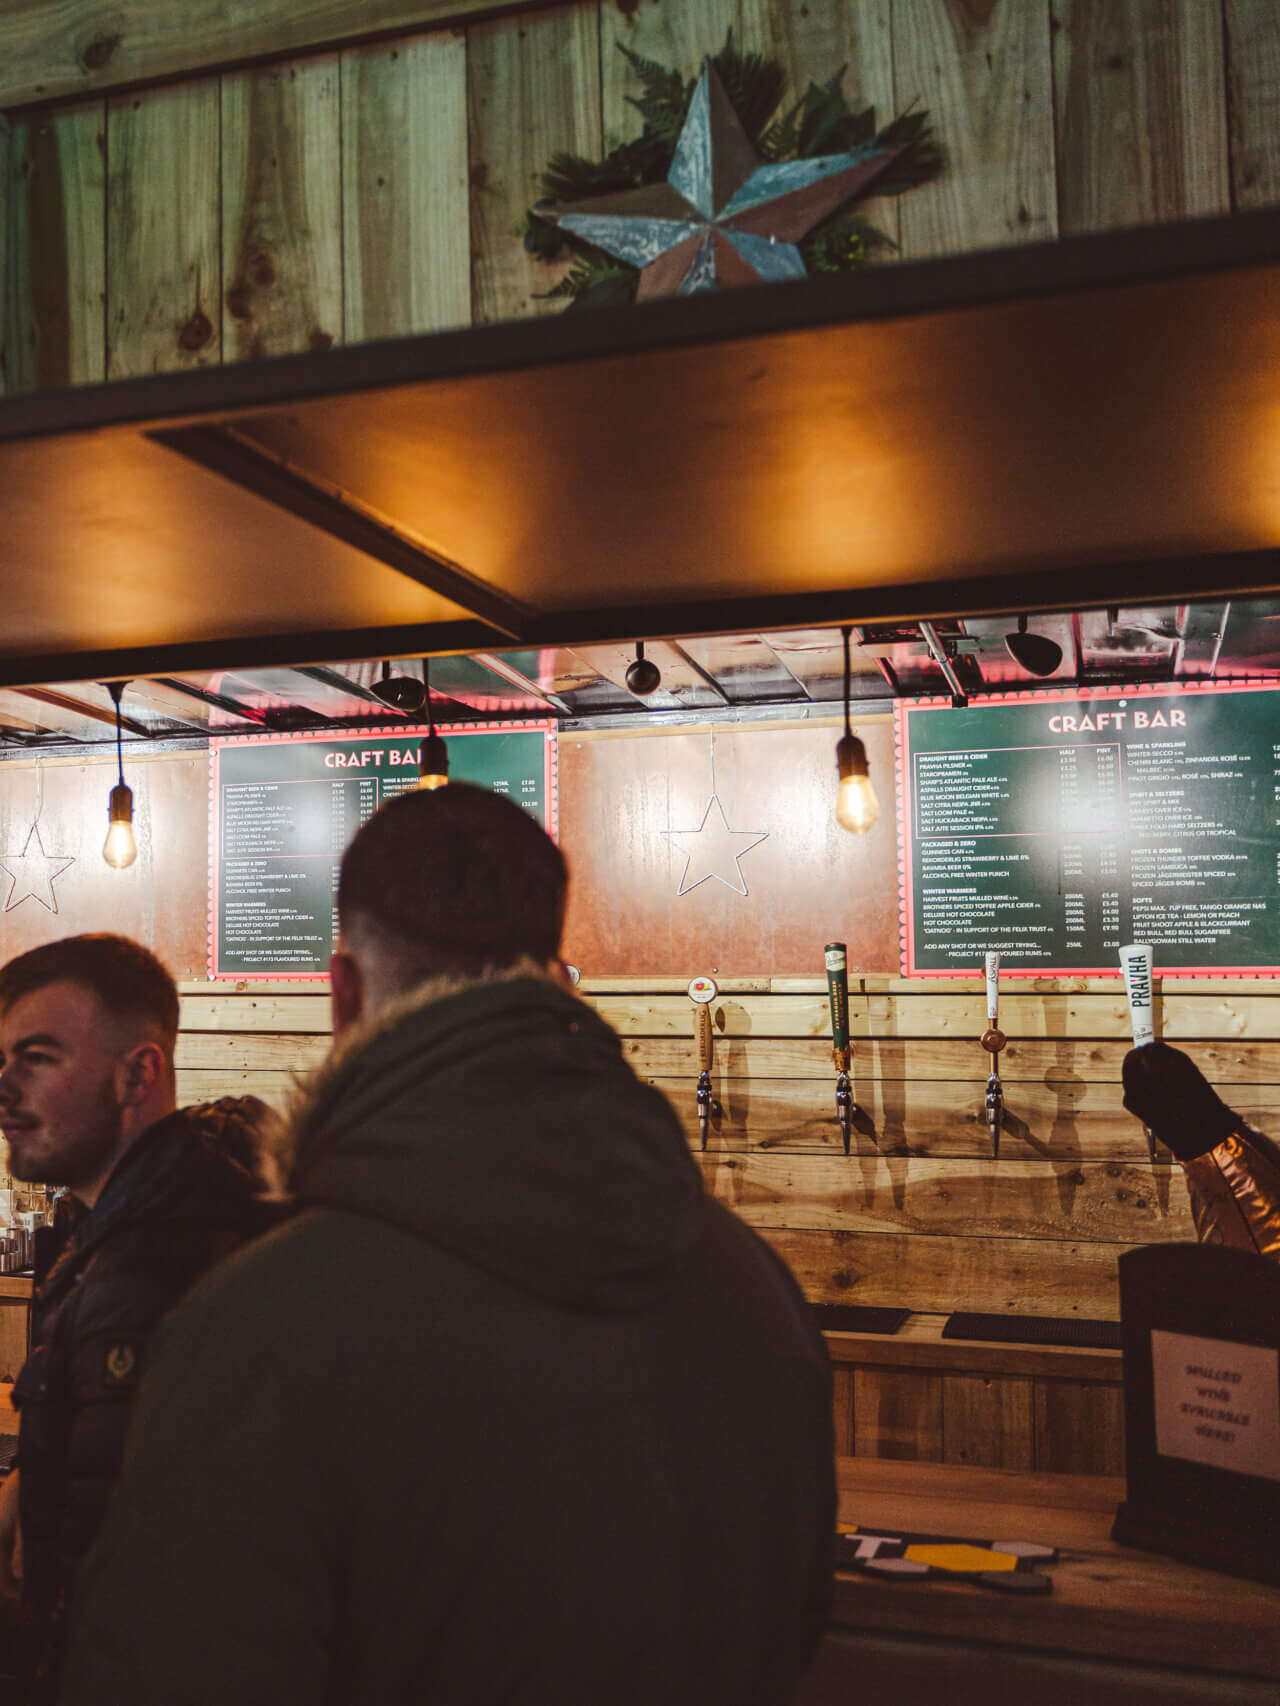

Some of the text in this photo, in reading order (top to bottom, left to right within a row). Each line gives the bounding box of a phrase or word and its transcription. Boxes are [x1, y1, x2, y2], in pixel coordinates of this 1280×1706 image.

[1048, 709, 1187, 733] CRAFT BAR
[324, 750, 385, 768] CRAFT
[1128, 954, 1151, 1008] PRAVHA
